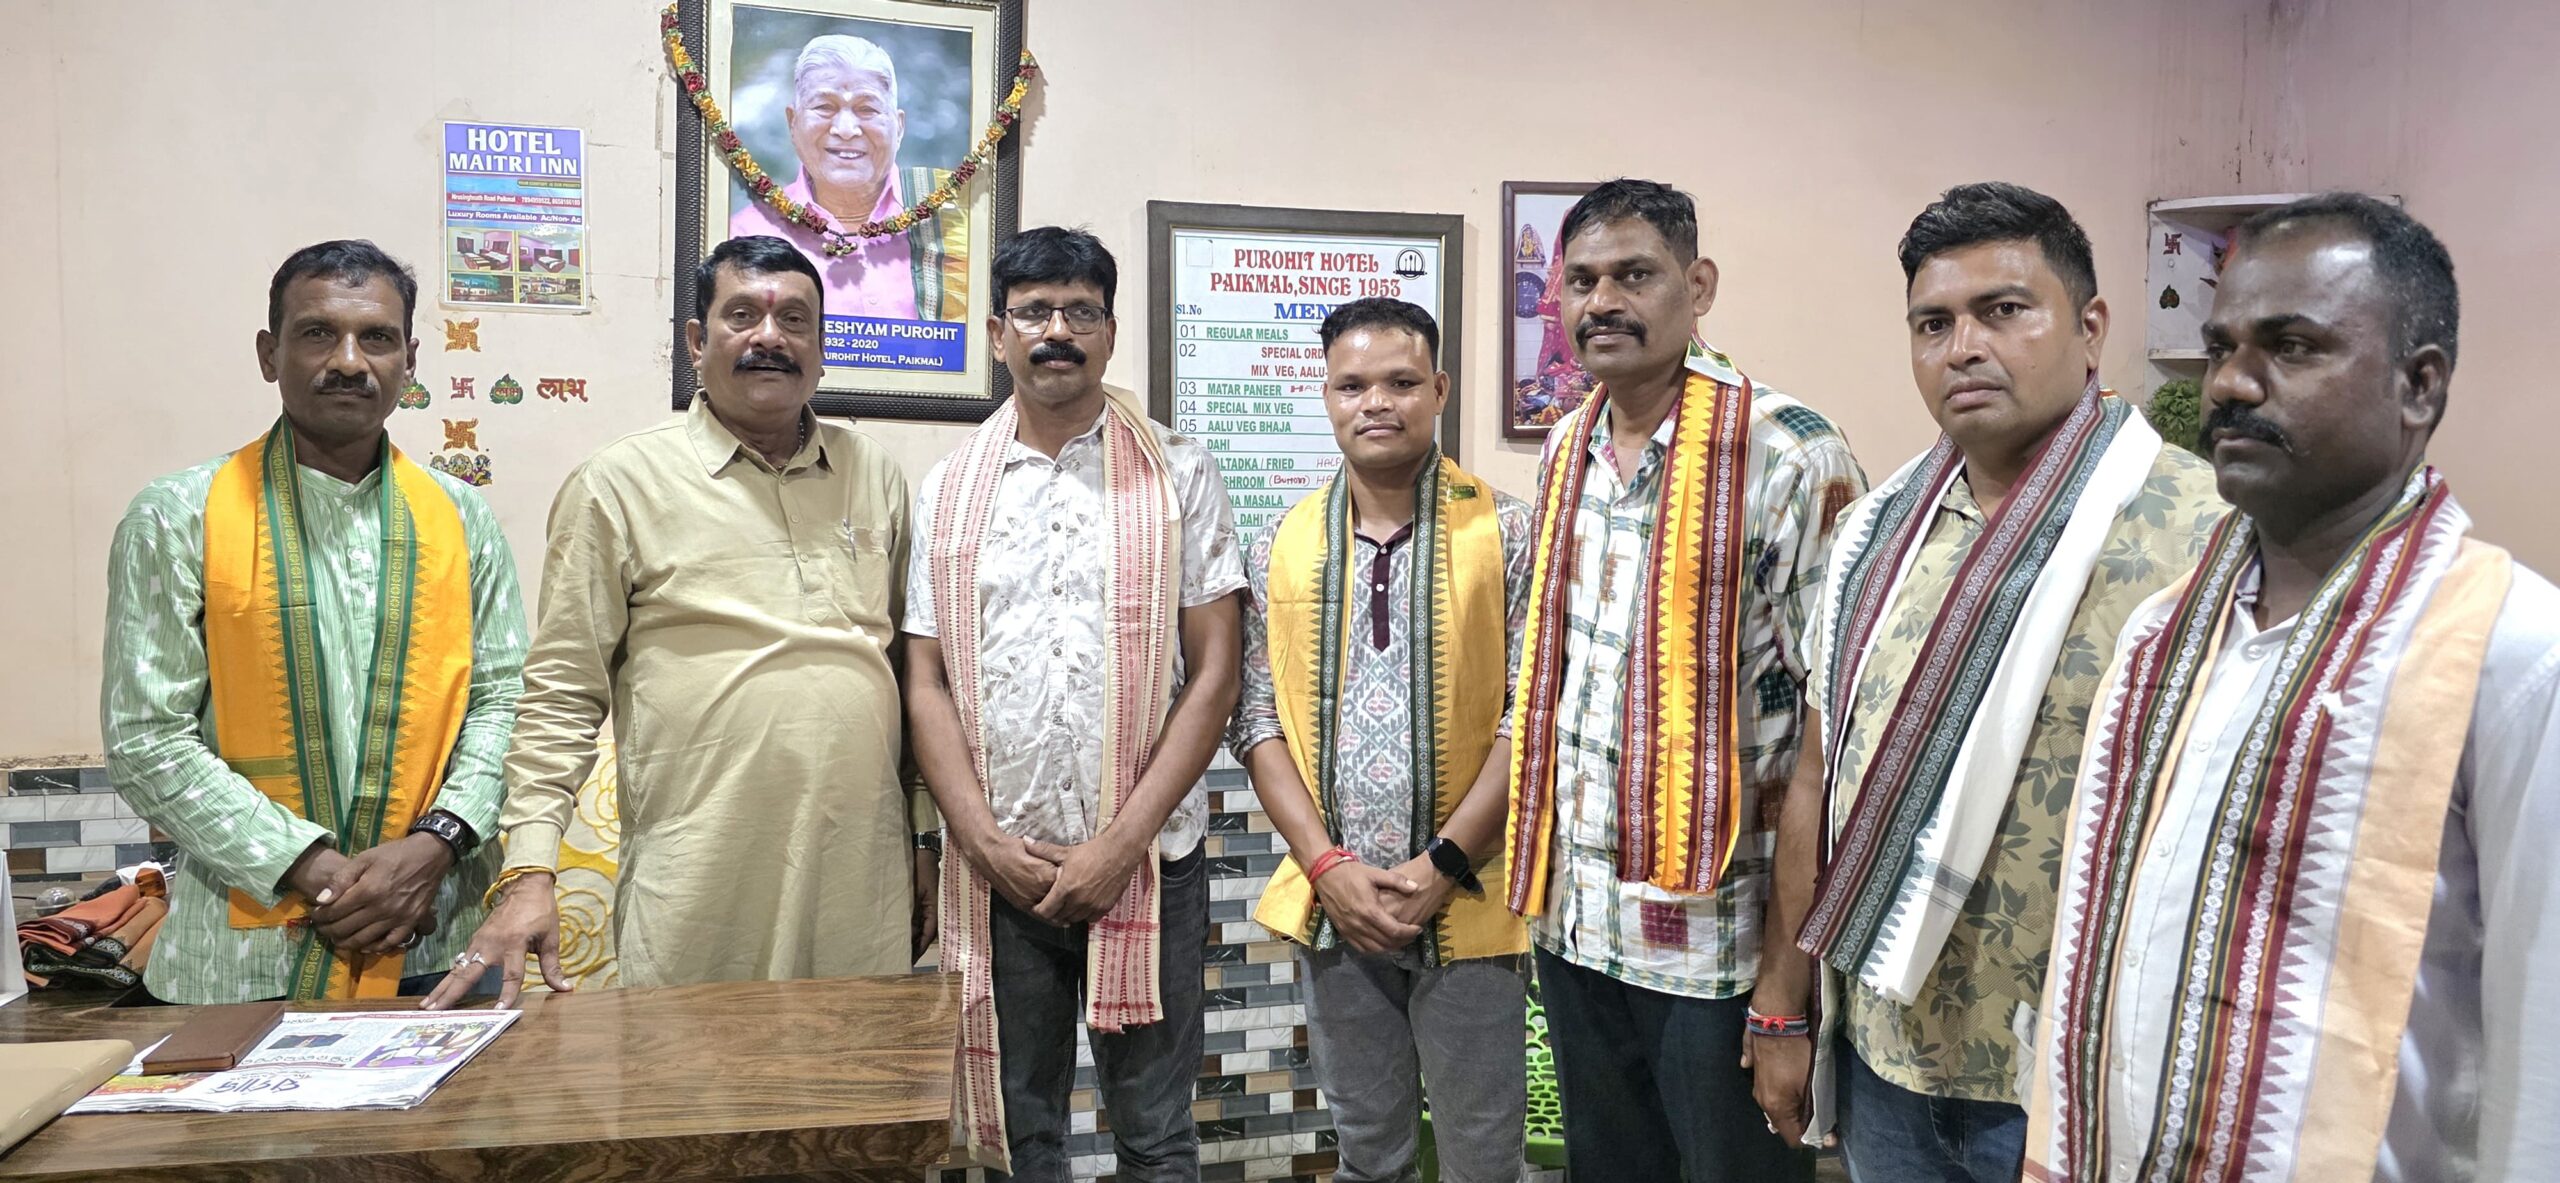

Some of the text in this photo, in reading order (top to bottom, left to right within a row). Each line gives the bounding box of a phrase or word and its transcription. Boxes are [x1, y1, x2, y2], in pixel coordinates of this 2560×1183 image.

[467, 128, 561, 155] HOTEL
[450, 153, 578, 175] MAITRI INN
[448, 210, 474, 219] Luxury
[475, 211, 502, 219] Rooms
[502, 212, 537, 221] Available
[1234, 248, 1379, 273] PUROHIT HOTEL
[1358, 278, 1401, 298] 1953
[1274, 303, 1341, 320] MEN
[824, 320, 958, 341] ESHYAM PUROHIT
[1180, 324, 1289, 341] 01 REGULAR MEALS
[824, 352, 860, 361] UROHIT
[1179, 343, 1325, 360] 02 SPECIAL ORD
[1251, 364, 1269, 377] MIX
[1274, 365, 1298, 379] VEG,
[537, 378, 589, 403] लाभ
[1179, 381, 1282, 396] 03 MATAR PANEER
[1179, 400, 1294, 414] 04 SPECIAL MIX VEG
[1179, 418, 1292, 433] 05 AALU VEG BHAJA
[1206, 438, 1230, 450] DAHI
[1215, 457, 1259, 470] ALTADKA
[1266, 457, 1294, 470] FRIED
[1224, 476, 1265, 489] SHROOM
[1243, 494, 1284, 507] MASALA
[1240, 513, 1263, 525] DAHI
